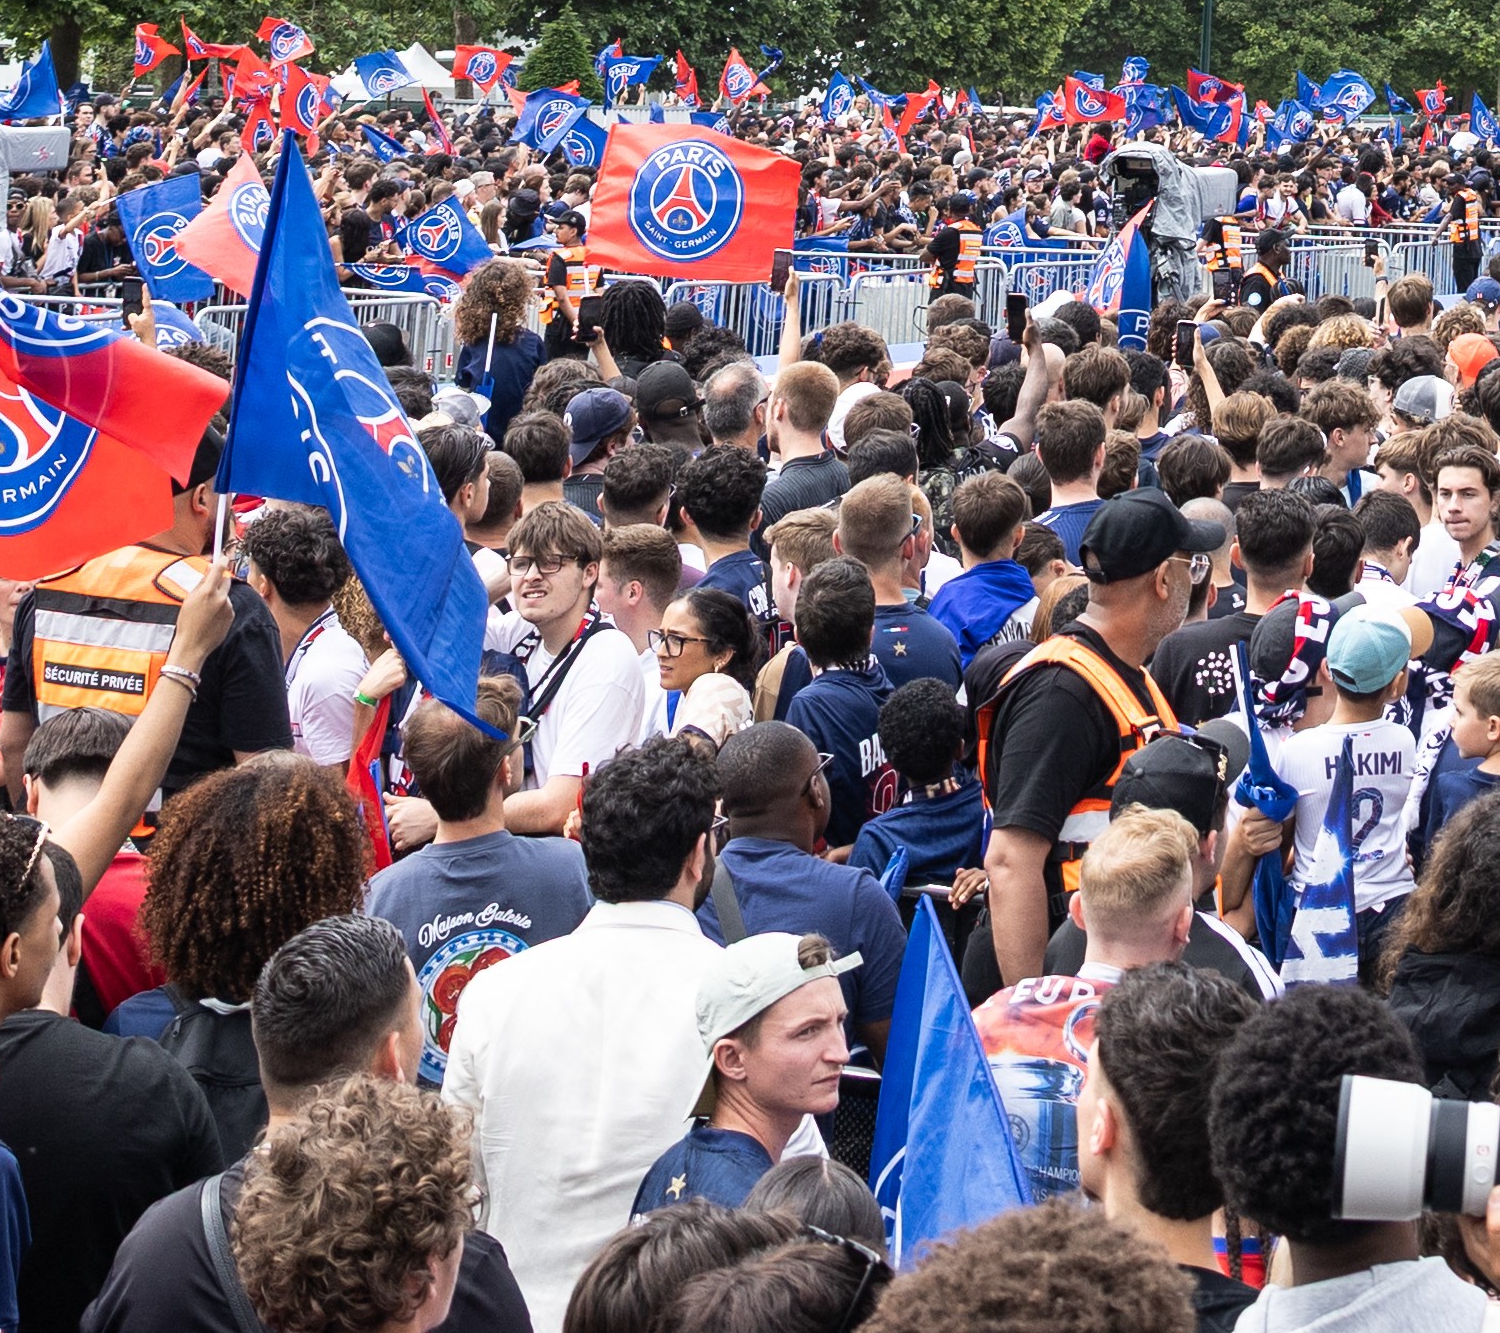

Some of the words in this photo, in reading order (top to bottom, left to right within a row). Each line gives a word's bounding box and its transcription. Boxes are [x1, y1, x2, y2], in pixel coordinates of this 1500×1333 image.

[654, 146, 726, 178] PARIS
[643, 220, 668, 244] SAINT
[674, 228, 717, 249] GERMAIN
[44, 664, 99, 686] SÉCURITÉ
[101, 671, 144, 691] PRIVÉE
[1325, 751, 1402, 780] HKIMI
[418, 911, 475, 948] Maison
[475, 902, 532, 929] Galerie
